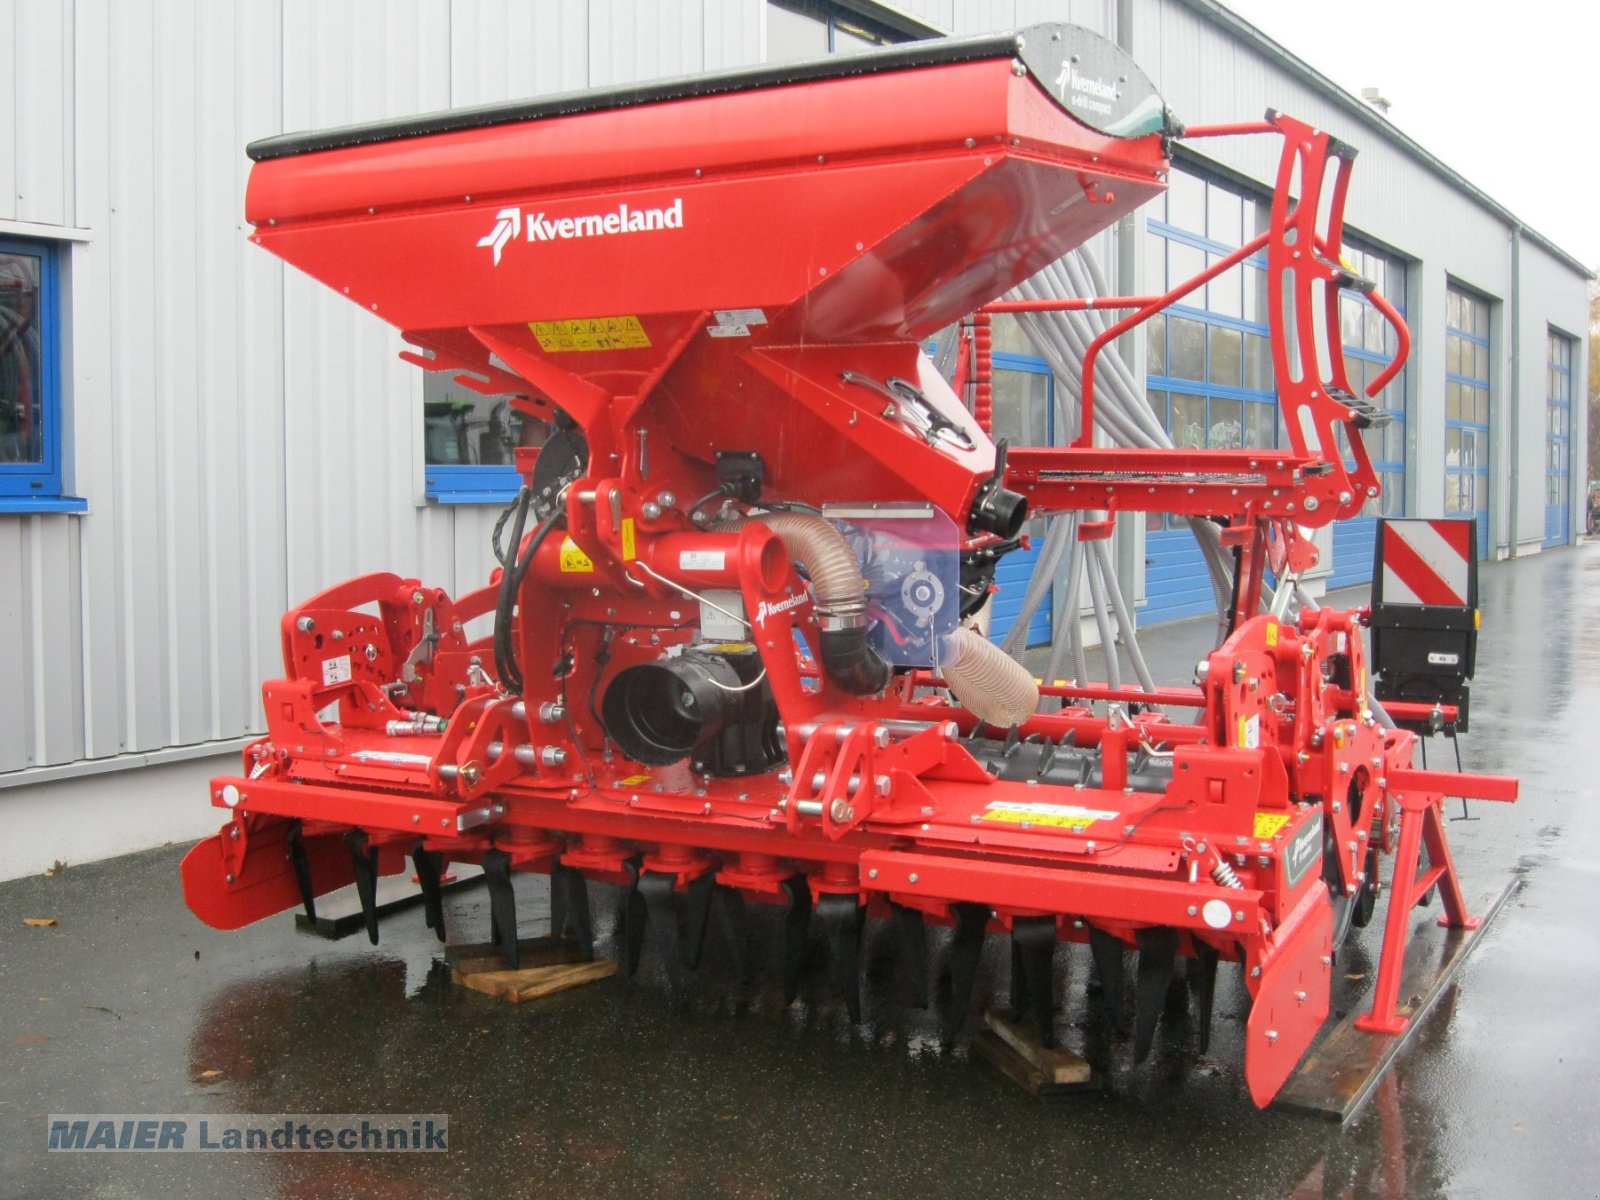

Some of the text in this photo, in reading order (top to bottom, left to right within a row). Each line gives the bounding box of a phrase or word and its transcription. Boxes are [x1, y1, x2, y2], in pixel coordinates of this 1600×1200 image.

[1071, 69, 1117, 101] Kverneland
[526, 198, 684, 242] Kverneland
[767, 589, 809, 616] Kverneland
